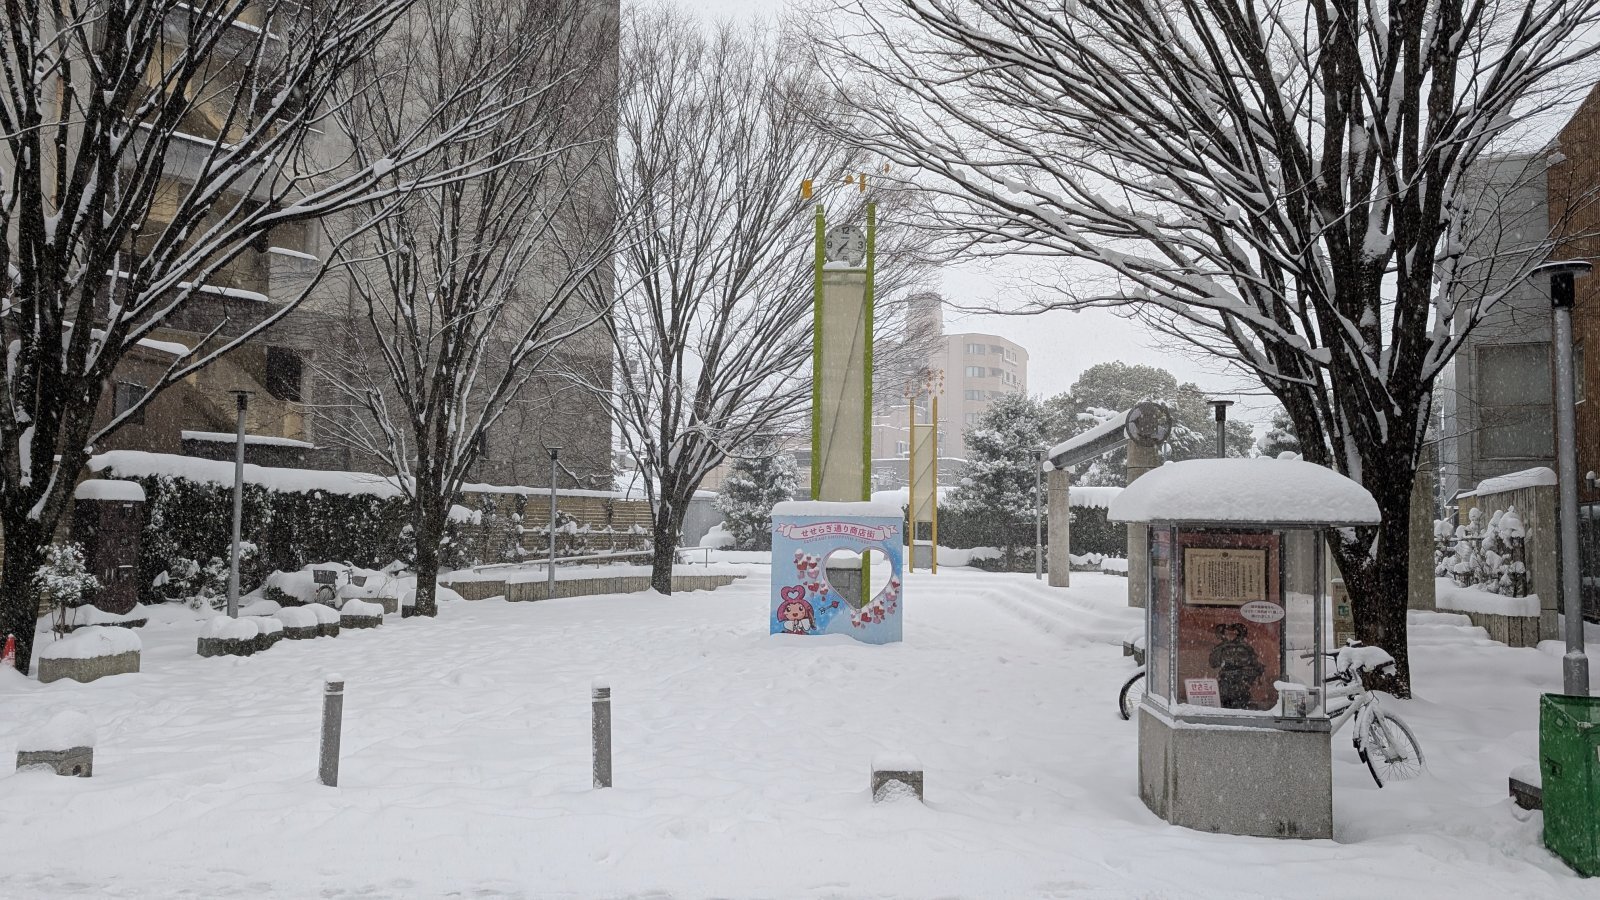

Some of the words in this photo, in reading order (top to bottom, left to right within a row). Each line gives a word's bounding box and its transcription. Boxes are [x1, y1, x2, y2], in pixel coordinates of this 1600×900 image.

[841, 227, 850, 235] 12
[827, 241, 832, 249] 9
[858, 241, 863, 249] 3
[801, 524, 875, 539] せせらぎ通り商店街
